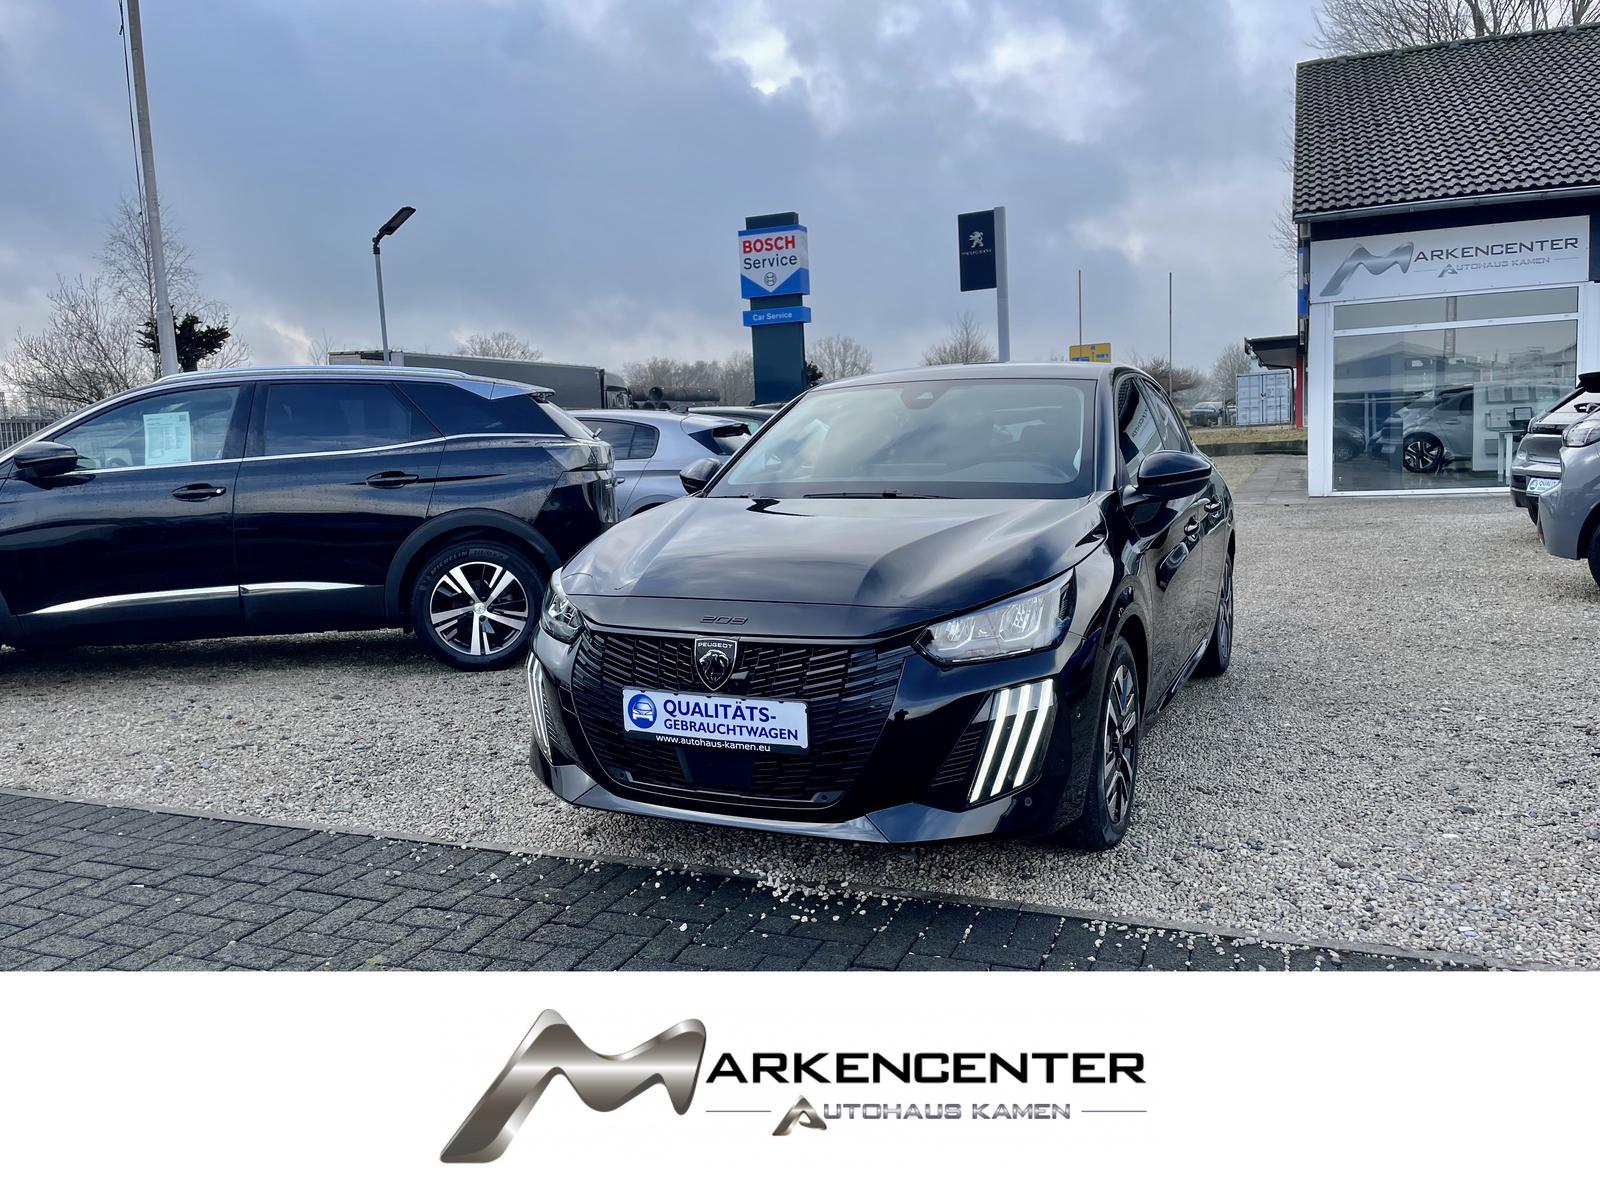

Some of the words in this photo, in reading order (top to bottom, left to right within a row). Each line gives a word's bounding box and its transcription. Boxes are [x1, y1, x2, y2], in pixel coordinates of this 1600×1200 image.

[742, 235, 796, 254] BOSCH
[743, 253, 798, 270] Service
[1437, 260, 1509, 278] AUTOHAUS
[1511, 256, 1551, 268] KAMEN
[752, 313, 765, 321] Car
[766, 311, 793, 320] Service
[430, 550, 468, 575] MICHELIN
[662, 698, 777, 723] QUALITÄTS-
[663, 717, 799, 741] GEBRAUCHTWAGEN
[655, 733, 772, 753] www.autohaus-kamen.eu
